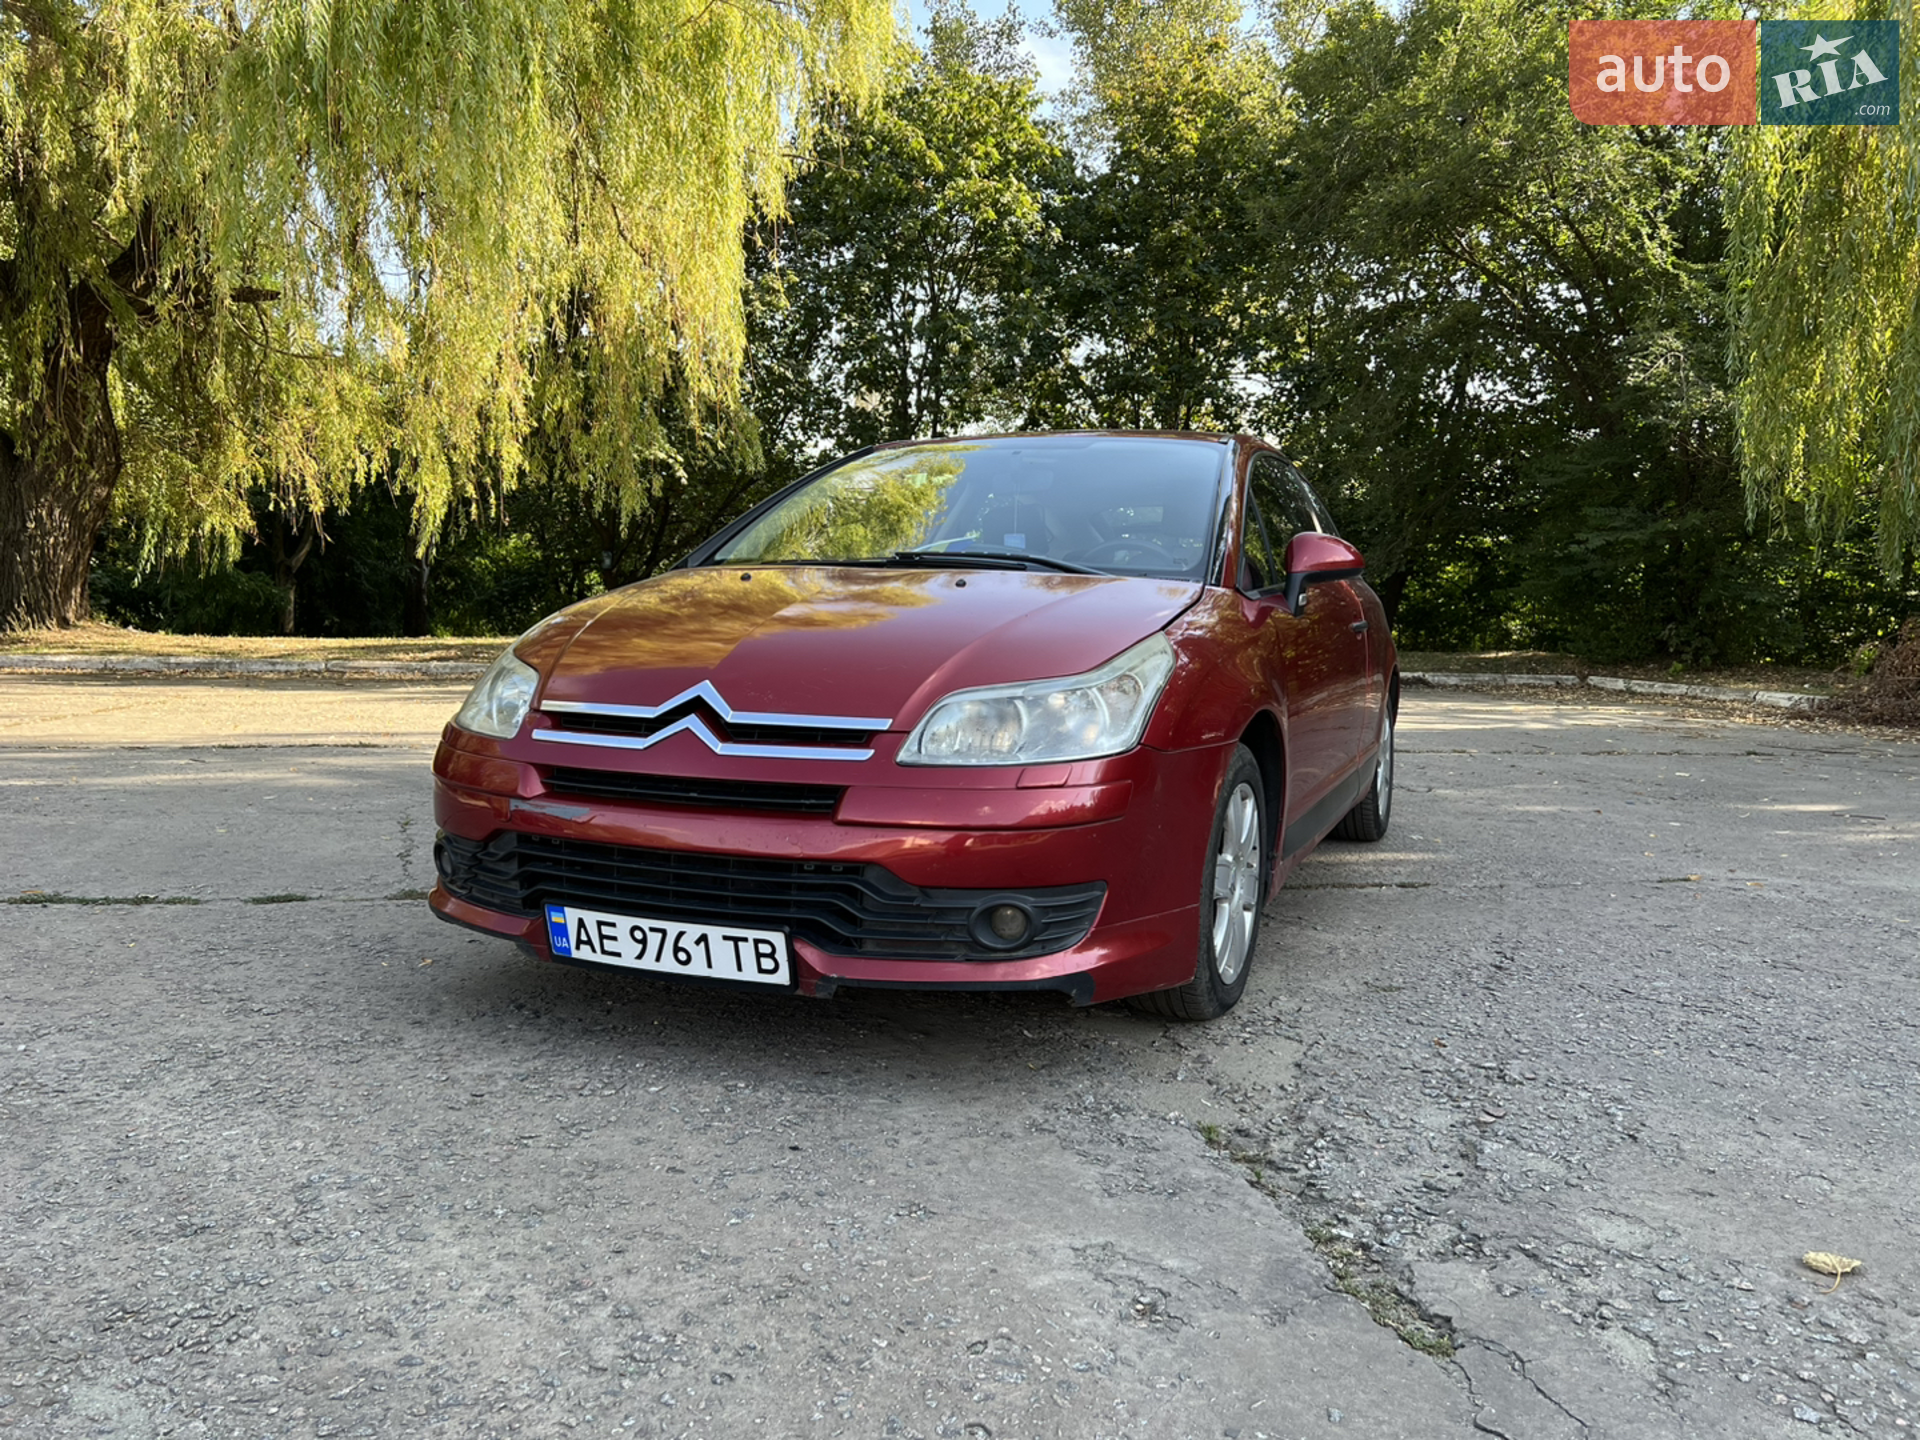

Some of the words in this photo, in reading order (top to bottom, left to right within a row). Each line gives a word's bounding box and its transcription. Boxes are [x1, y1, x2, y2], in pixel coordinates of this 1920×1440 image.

[553, 935, 570, 949] UA
[575, 917, 622, 958] AE
[629, 924, 713, 969] 9761
[722, 934, 780, 975] TB
